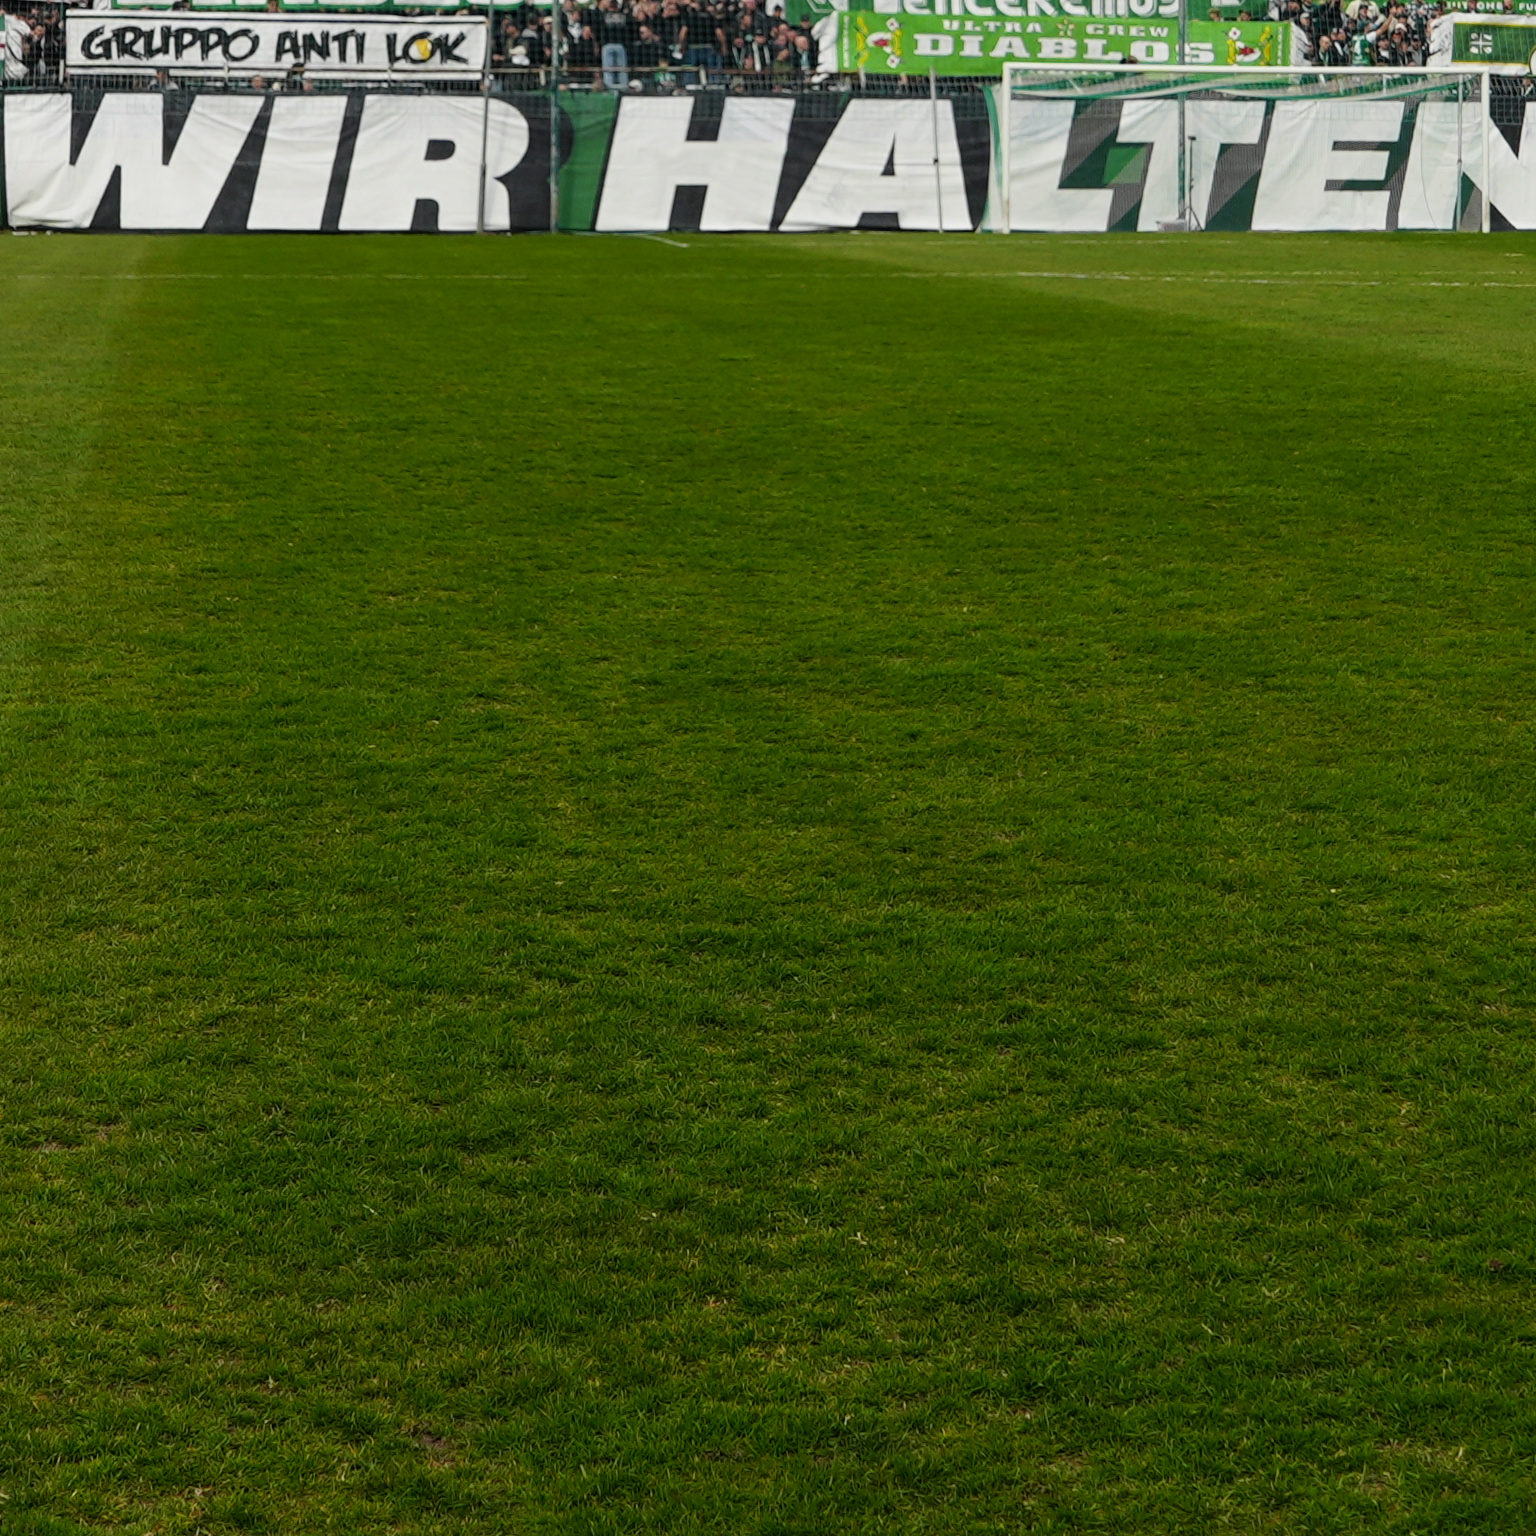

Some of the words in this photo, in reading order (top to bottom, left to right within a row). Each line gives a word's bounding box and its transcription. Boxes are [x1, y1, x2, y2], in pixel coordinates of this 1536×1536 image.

[942, 18, 1043, 33] ULTRA
[80, 25, 260, 63] GRUPPO
[275, 29, 366, 64] ANTI
[386, 30, 469, 65] LOK
[913, 32, 1216, 64] DIABLOS
[3, 93, 529, 231] WIR
